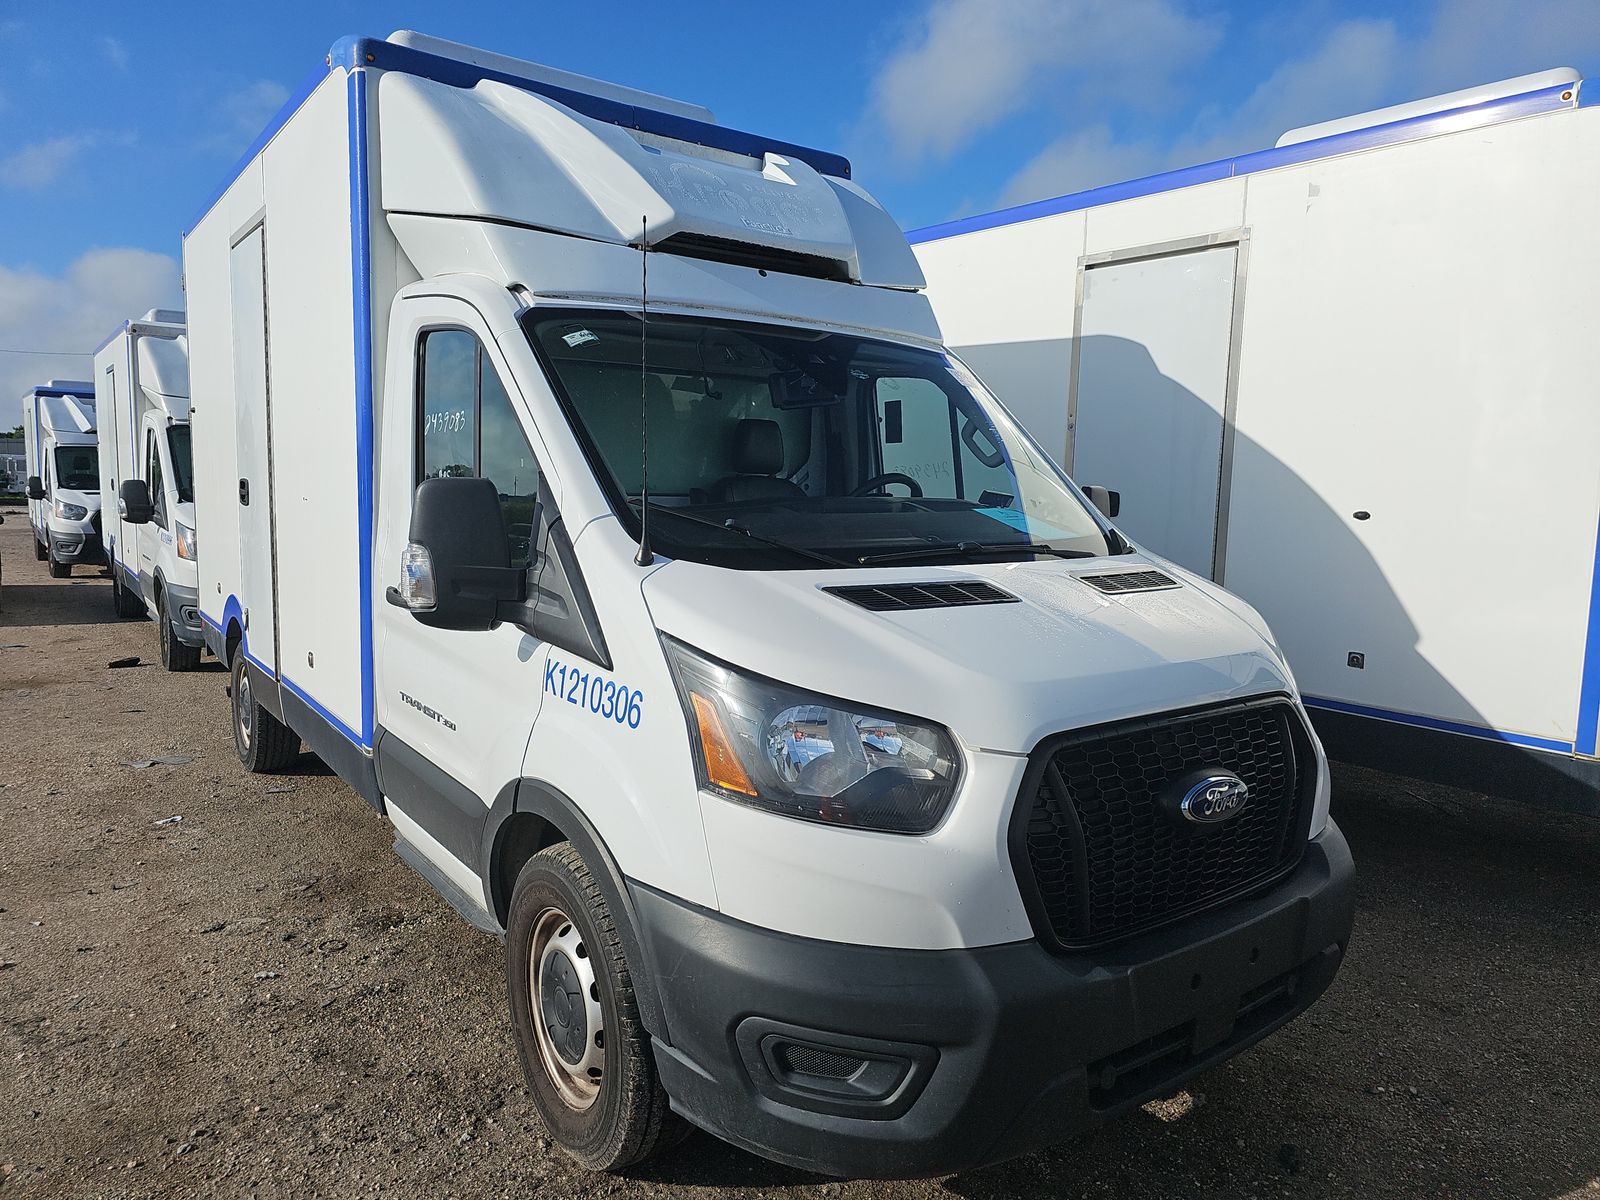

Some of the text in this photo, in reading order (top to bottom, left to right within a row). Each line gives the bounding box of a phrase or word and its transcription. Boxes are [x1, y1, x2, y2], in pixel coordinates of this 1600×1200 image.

[425, 410, 465, 436] 2439083
[399, 690, 457, 731] TRANSIT 350
[545, 658, 643, 730] K1210306
[1203, 785, 1239, 815] Ford
